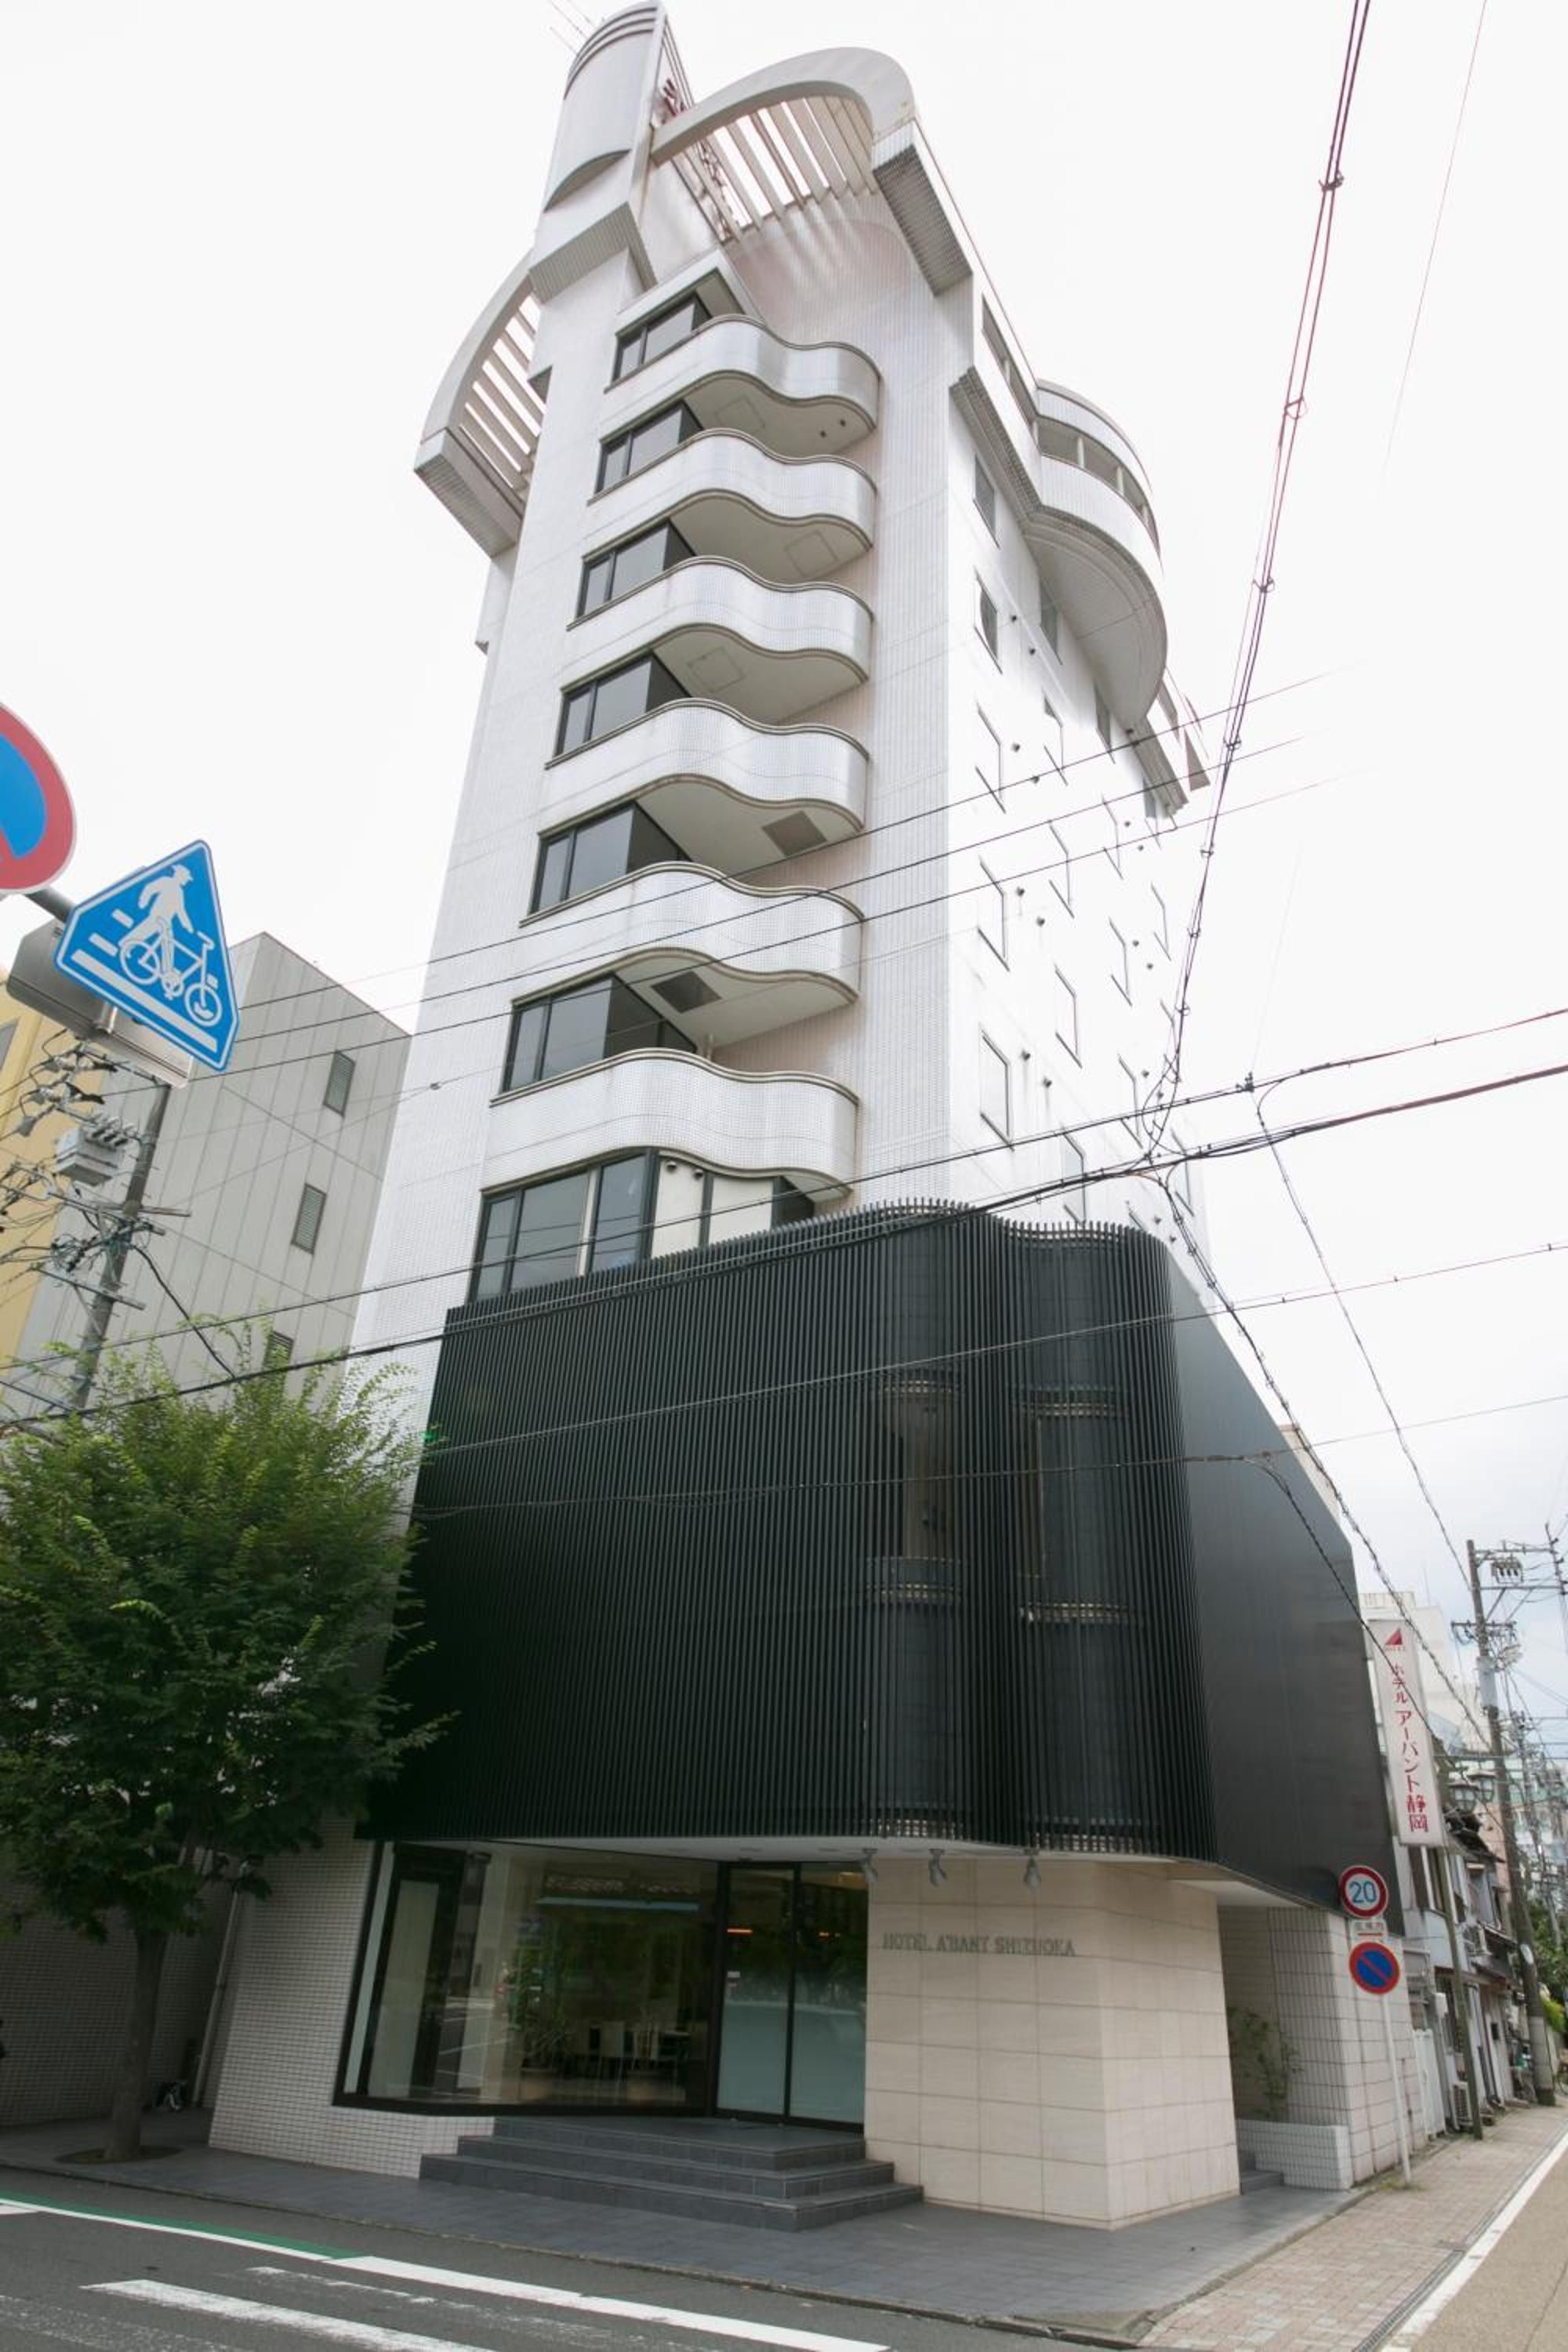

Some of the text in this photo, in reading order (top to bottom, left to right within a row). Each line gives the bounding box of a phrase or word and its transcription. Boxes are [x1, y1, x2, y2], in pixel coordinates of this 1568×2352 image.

[1349, 1881, 1377, 1904] 20
[882, 1932, 930, 1951] HOTEL
[994, 1936, 1076, 1956] SHIZUOKA
